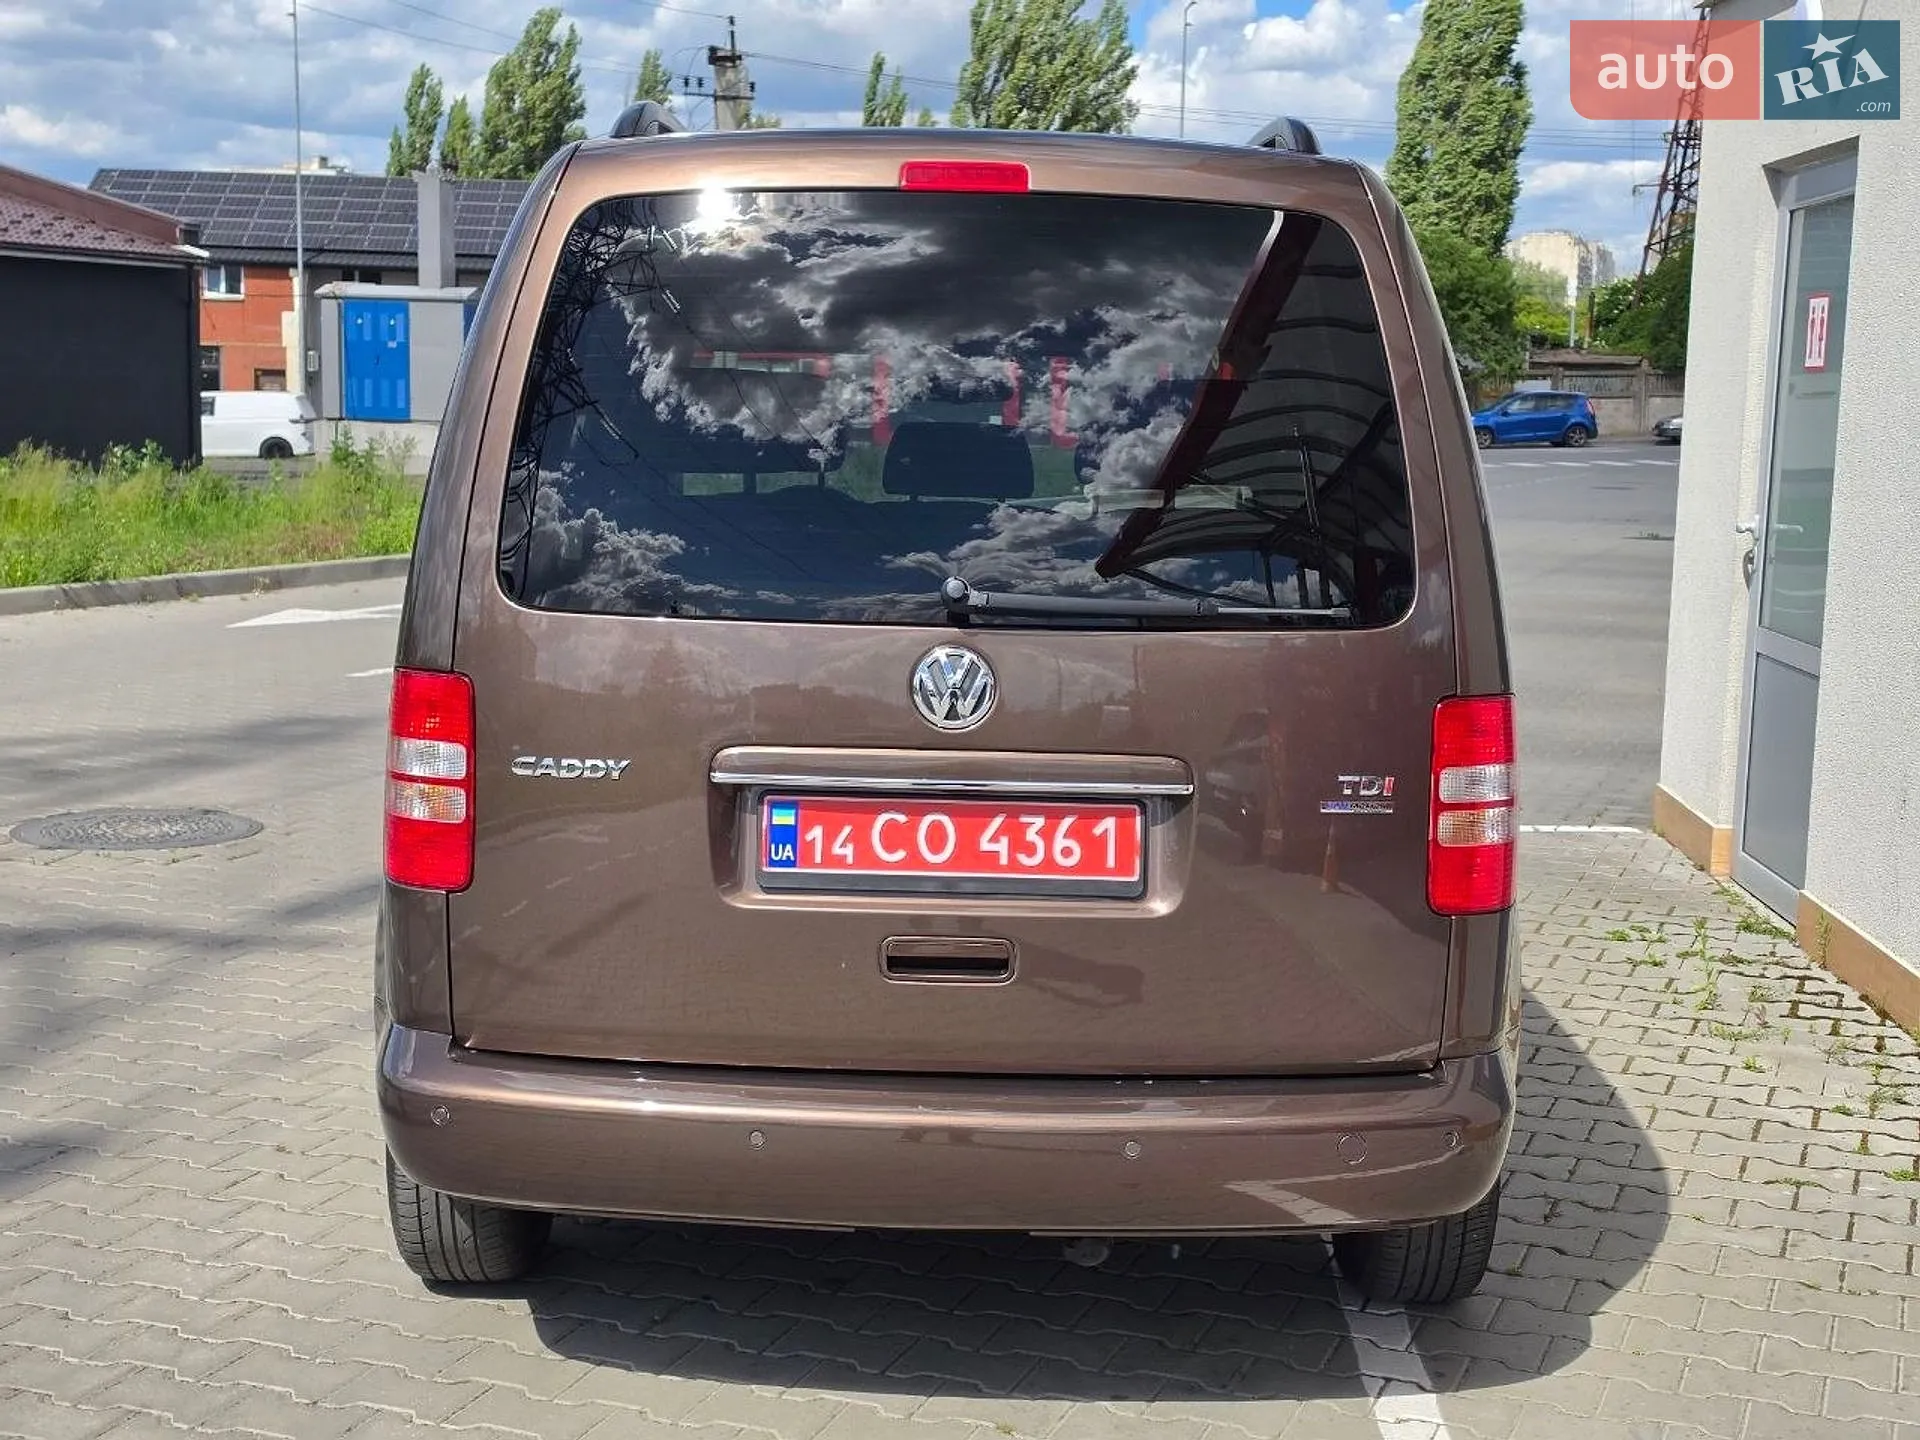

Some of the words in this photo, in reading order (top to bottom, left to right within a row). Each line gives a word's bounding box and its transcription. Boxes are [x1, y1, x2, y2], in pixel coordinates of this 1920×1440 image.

[511, 756, 631, 780] CADDY
[1338, 775, 1394, 796] TDI
[804, 825, 854, 865] 14
[871, 811, 957, 864] CO
[979, 813, 1117, 868] 4361
[770, 843, 794, 860] UA
